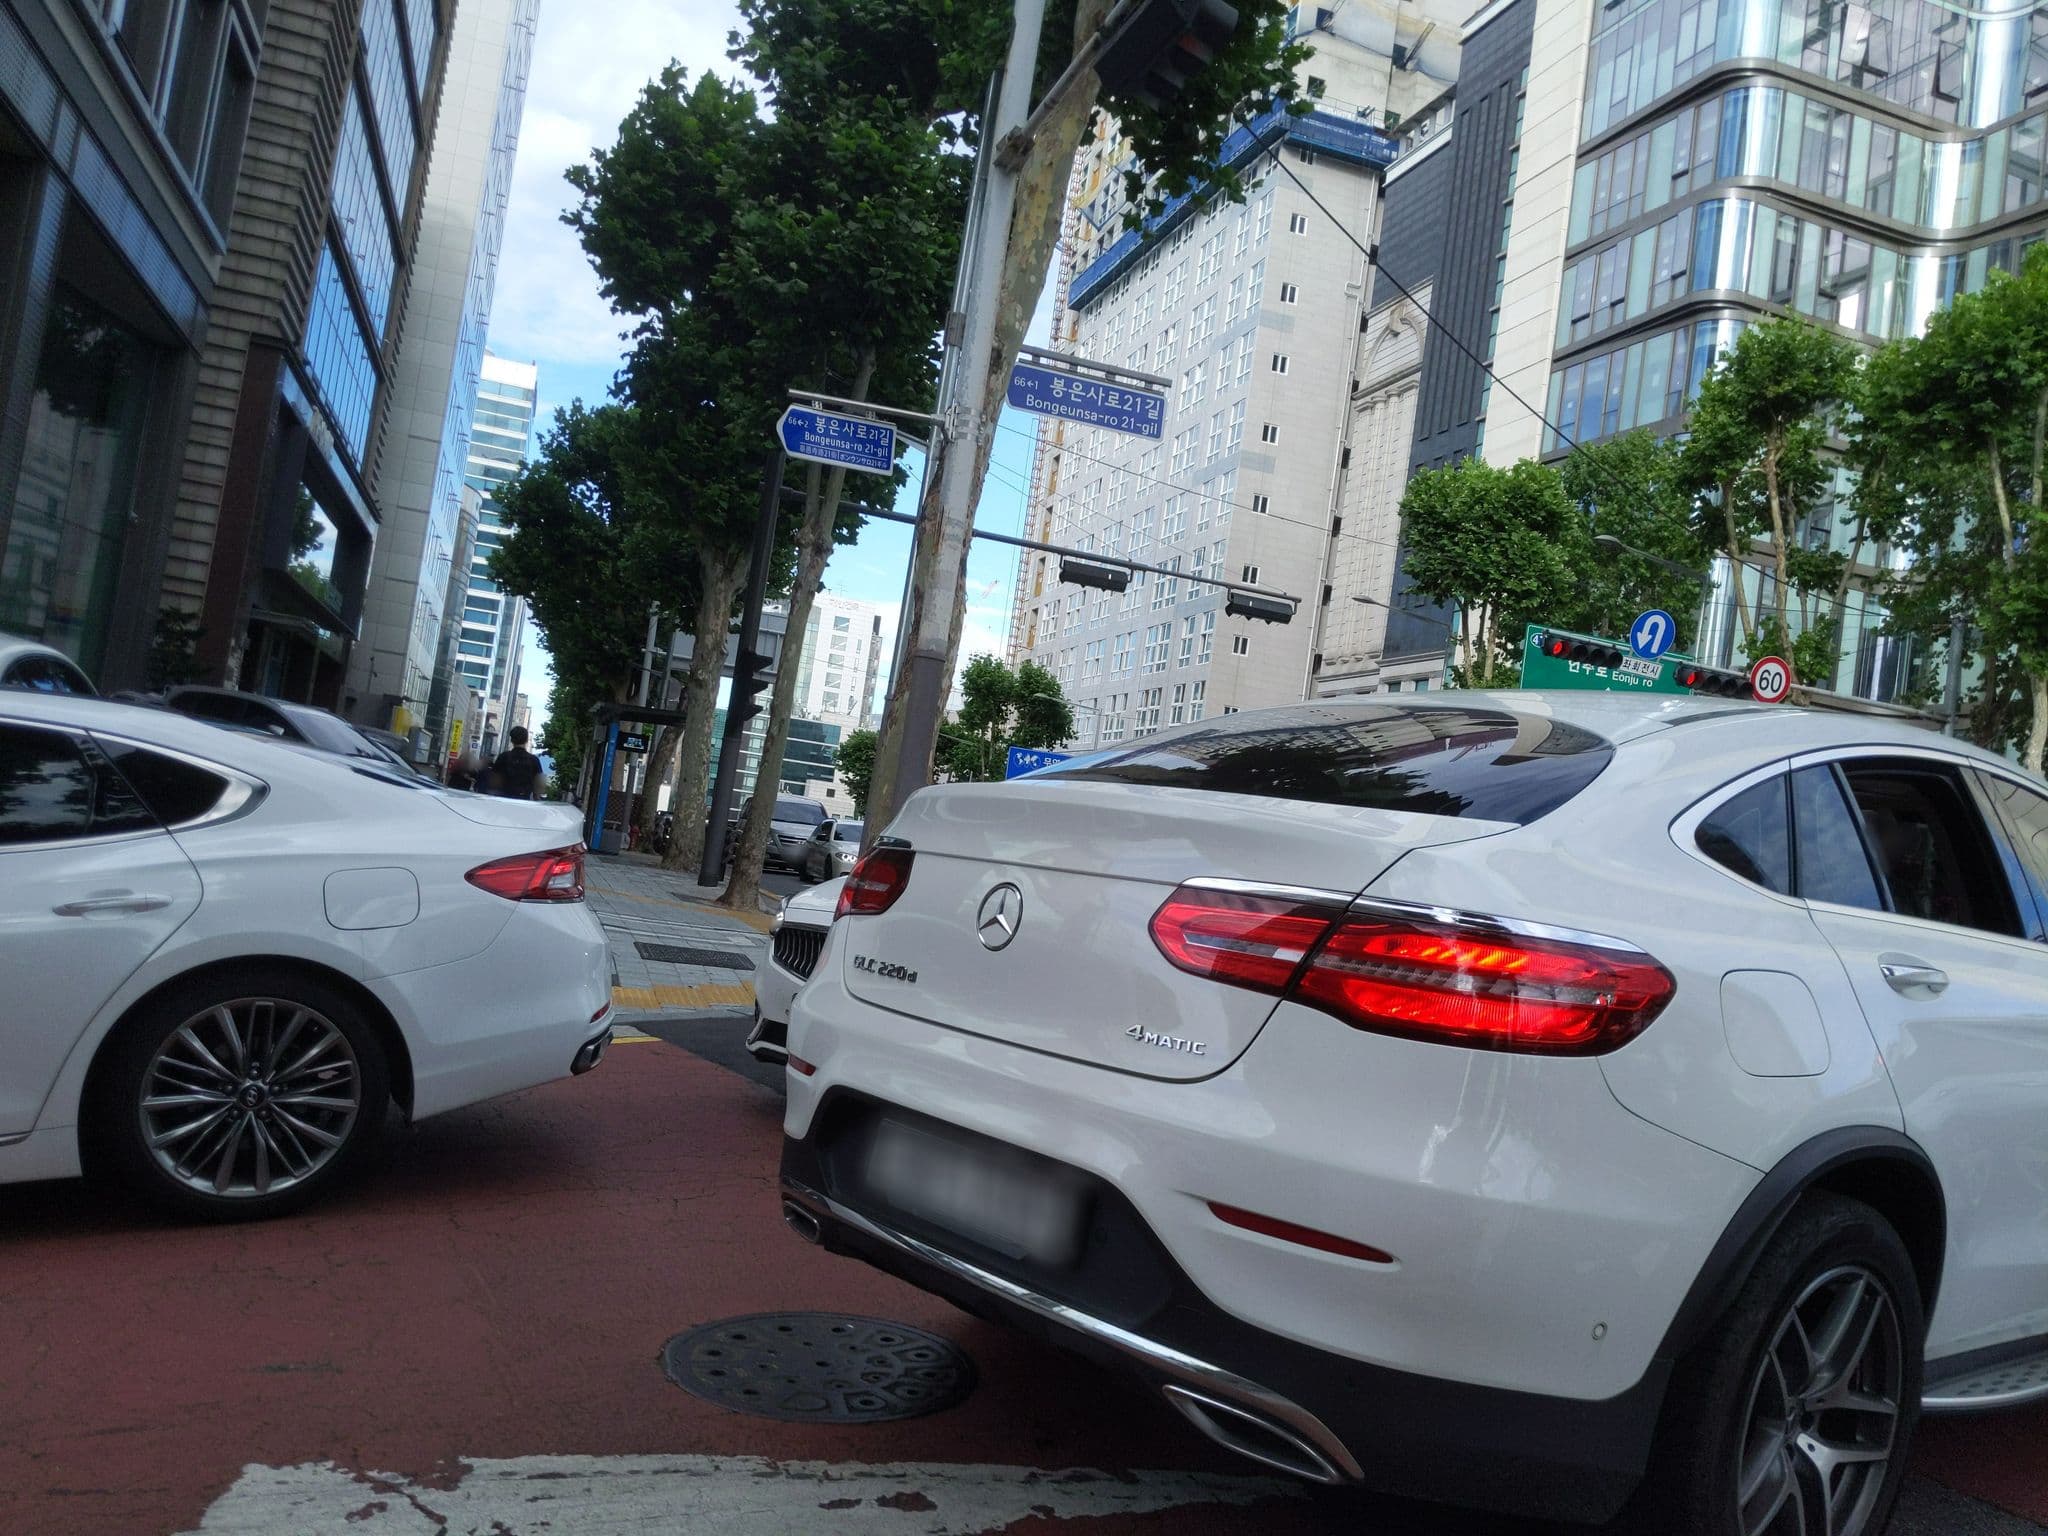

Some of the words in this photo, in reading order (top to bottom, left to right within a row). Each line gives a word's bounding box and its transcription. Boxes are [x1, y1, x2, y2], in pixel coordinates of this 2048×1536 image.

[1050, 377, 1160, 420] 봉은사로21길
[1026, 394, 1118, 426] Bongeunsa-ro
[1121, 416, 1158, 436] 21-gil
[804, 431, 863, 452] Bongeunsa-ro
[864, 444, 889, 457] 21-gil
[815, 416, 890, 446] 봉은사로21길
[1612, 670, 1640, 688] Eonju
[1642, 675, 1653, 688] ro
[1622, 658, 1660, 676] 좌회전시
[1758, 669, 1783, 694] 60
[854, 955, 877, 973] GLC
[1125, 1023, 1206, 1056] 4MATIC
